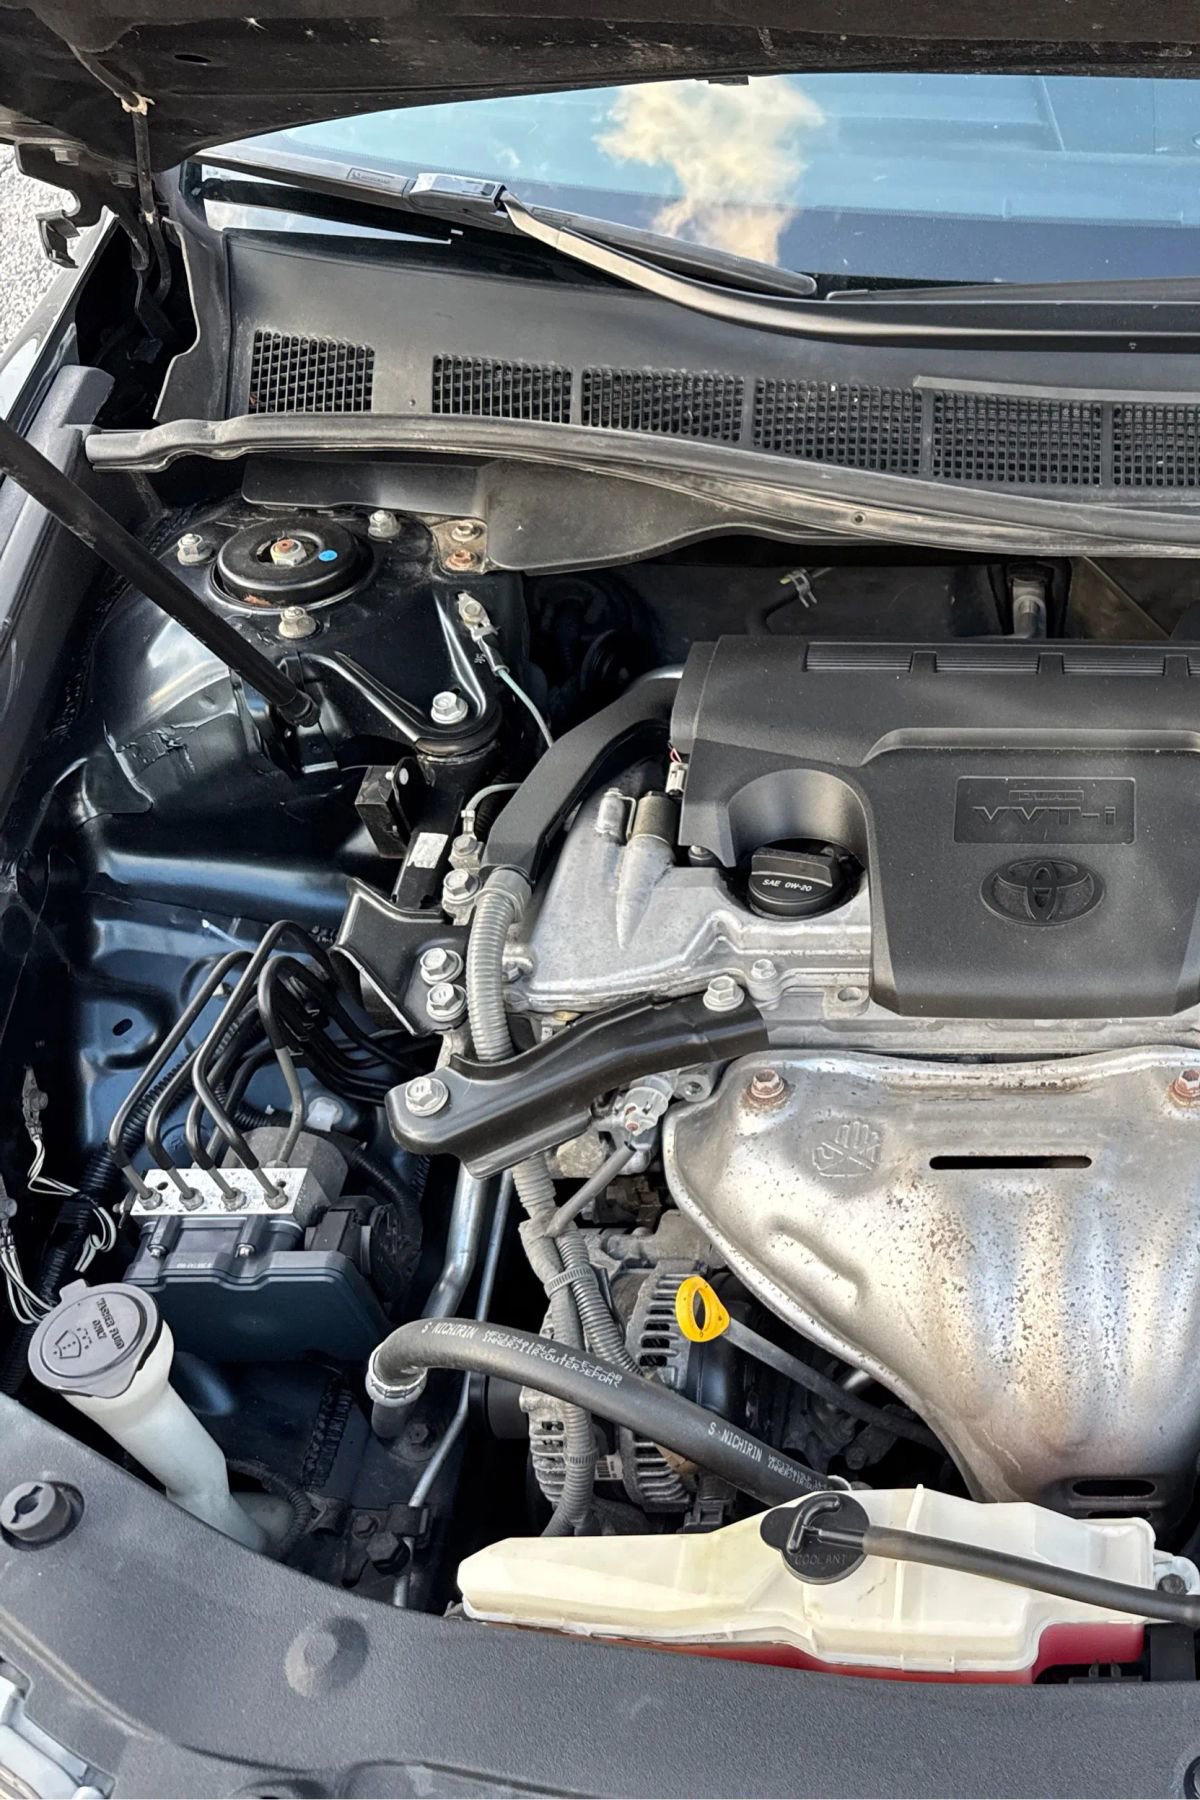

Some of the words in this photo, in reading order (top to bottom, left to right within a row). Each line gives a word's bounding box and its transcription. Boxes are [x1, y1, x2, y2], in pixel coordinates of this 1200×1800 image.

[972, 806, 1116, 825] VVT-i
[762, 879, 782, 888] SAE
[784, 882, 813, 892] 0W-20
[795, 1553, 847, 1565] COOLANT
